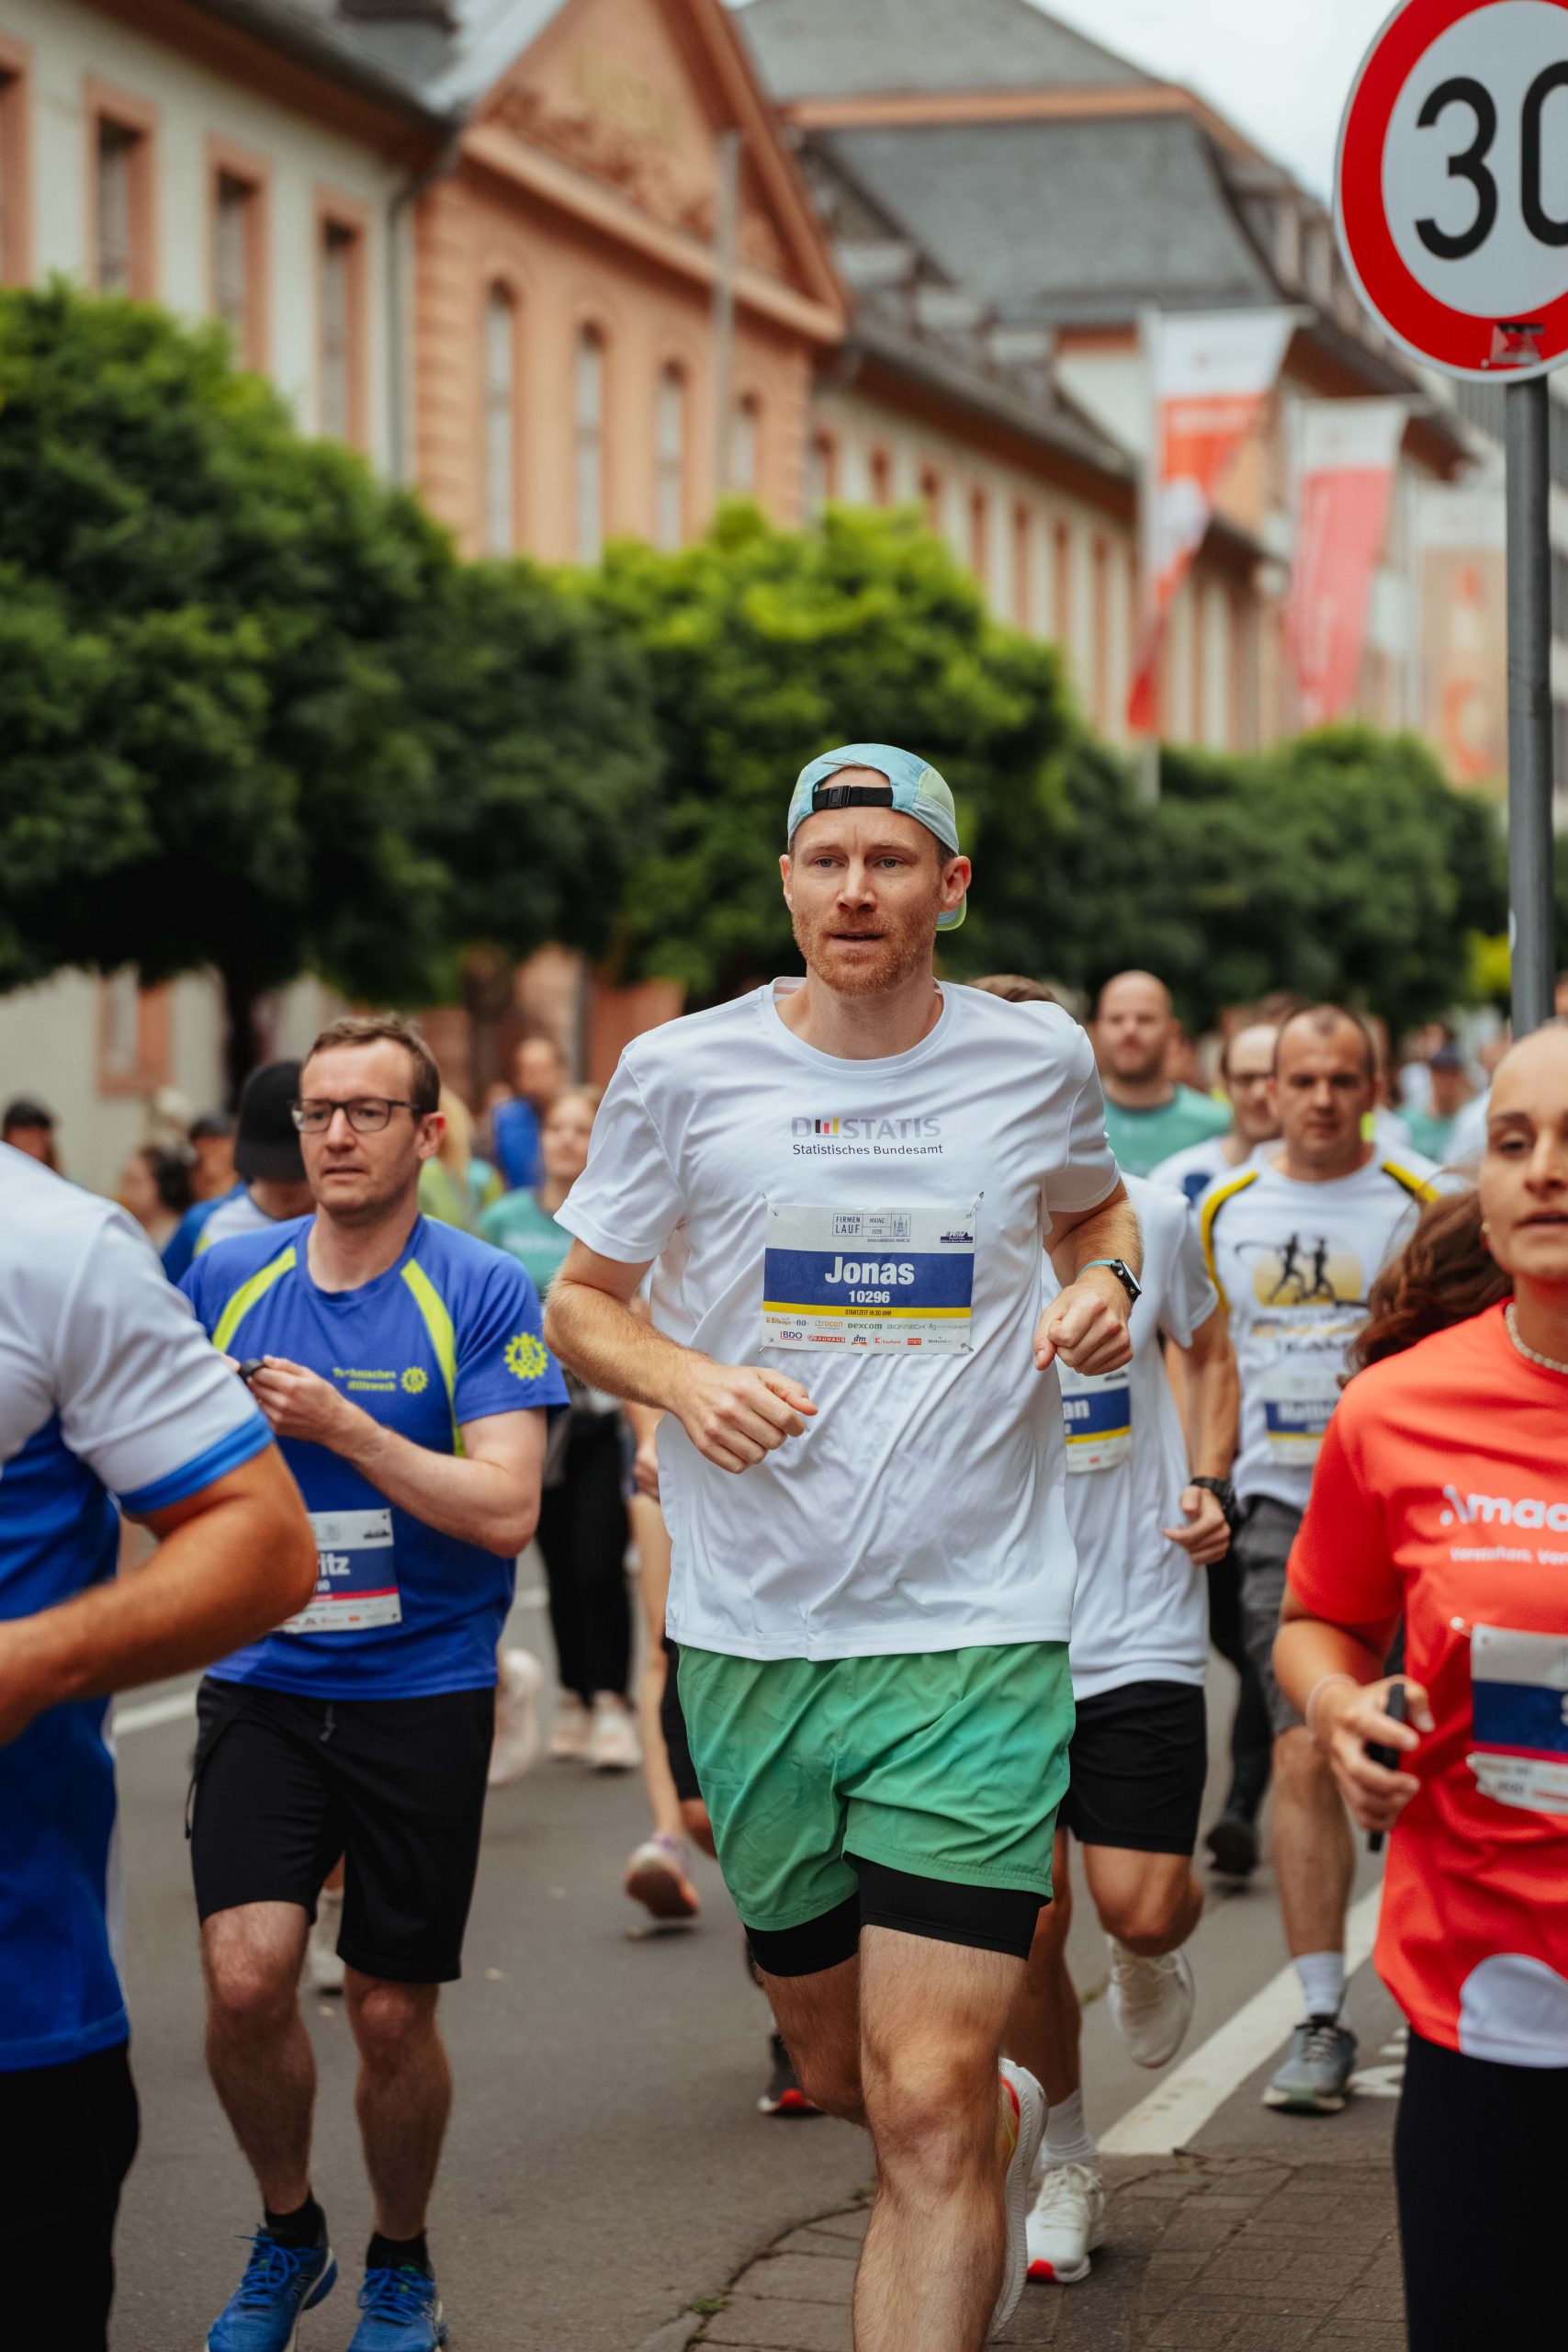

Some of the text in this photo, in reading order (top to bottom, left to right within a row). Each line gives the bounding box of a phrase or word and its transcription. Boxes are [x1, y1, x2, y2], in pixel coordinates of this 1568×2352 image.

[1415, 59, 1568, 261] 30
[793, 1144, 943, 1156] Statistisches Bundesamt
[836, 1216, 861, 1224] FIRMEN
[835, 1224, 861, 1234] LAUF
[824, 1256, 915, 1285] Jonas
[849, 1290, 891, 1304] 10296
[783, 1330, 803, 1339] BDO
[813, 1335, 845, 1343] BAUHAUS
[853, 1334, 866, 1342] dm
[318, 1552, 351, 1577] itz
